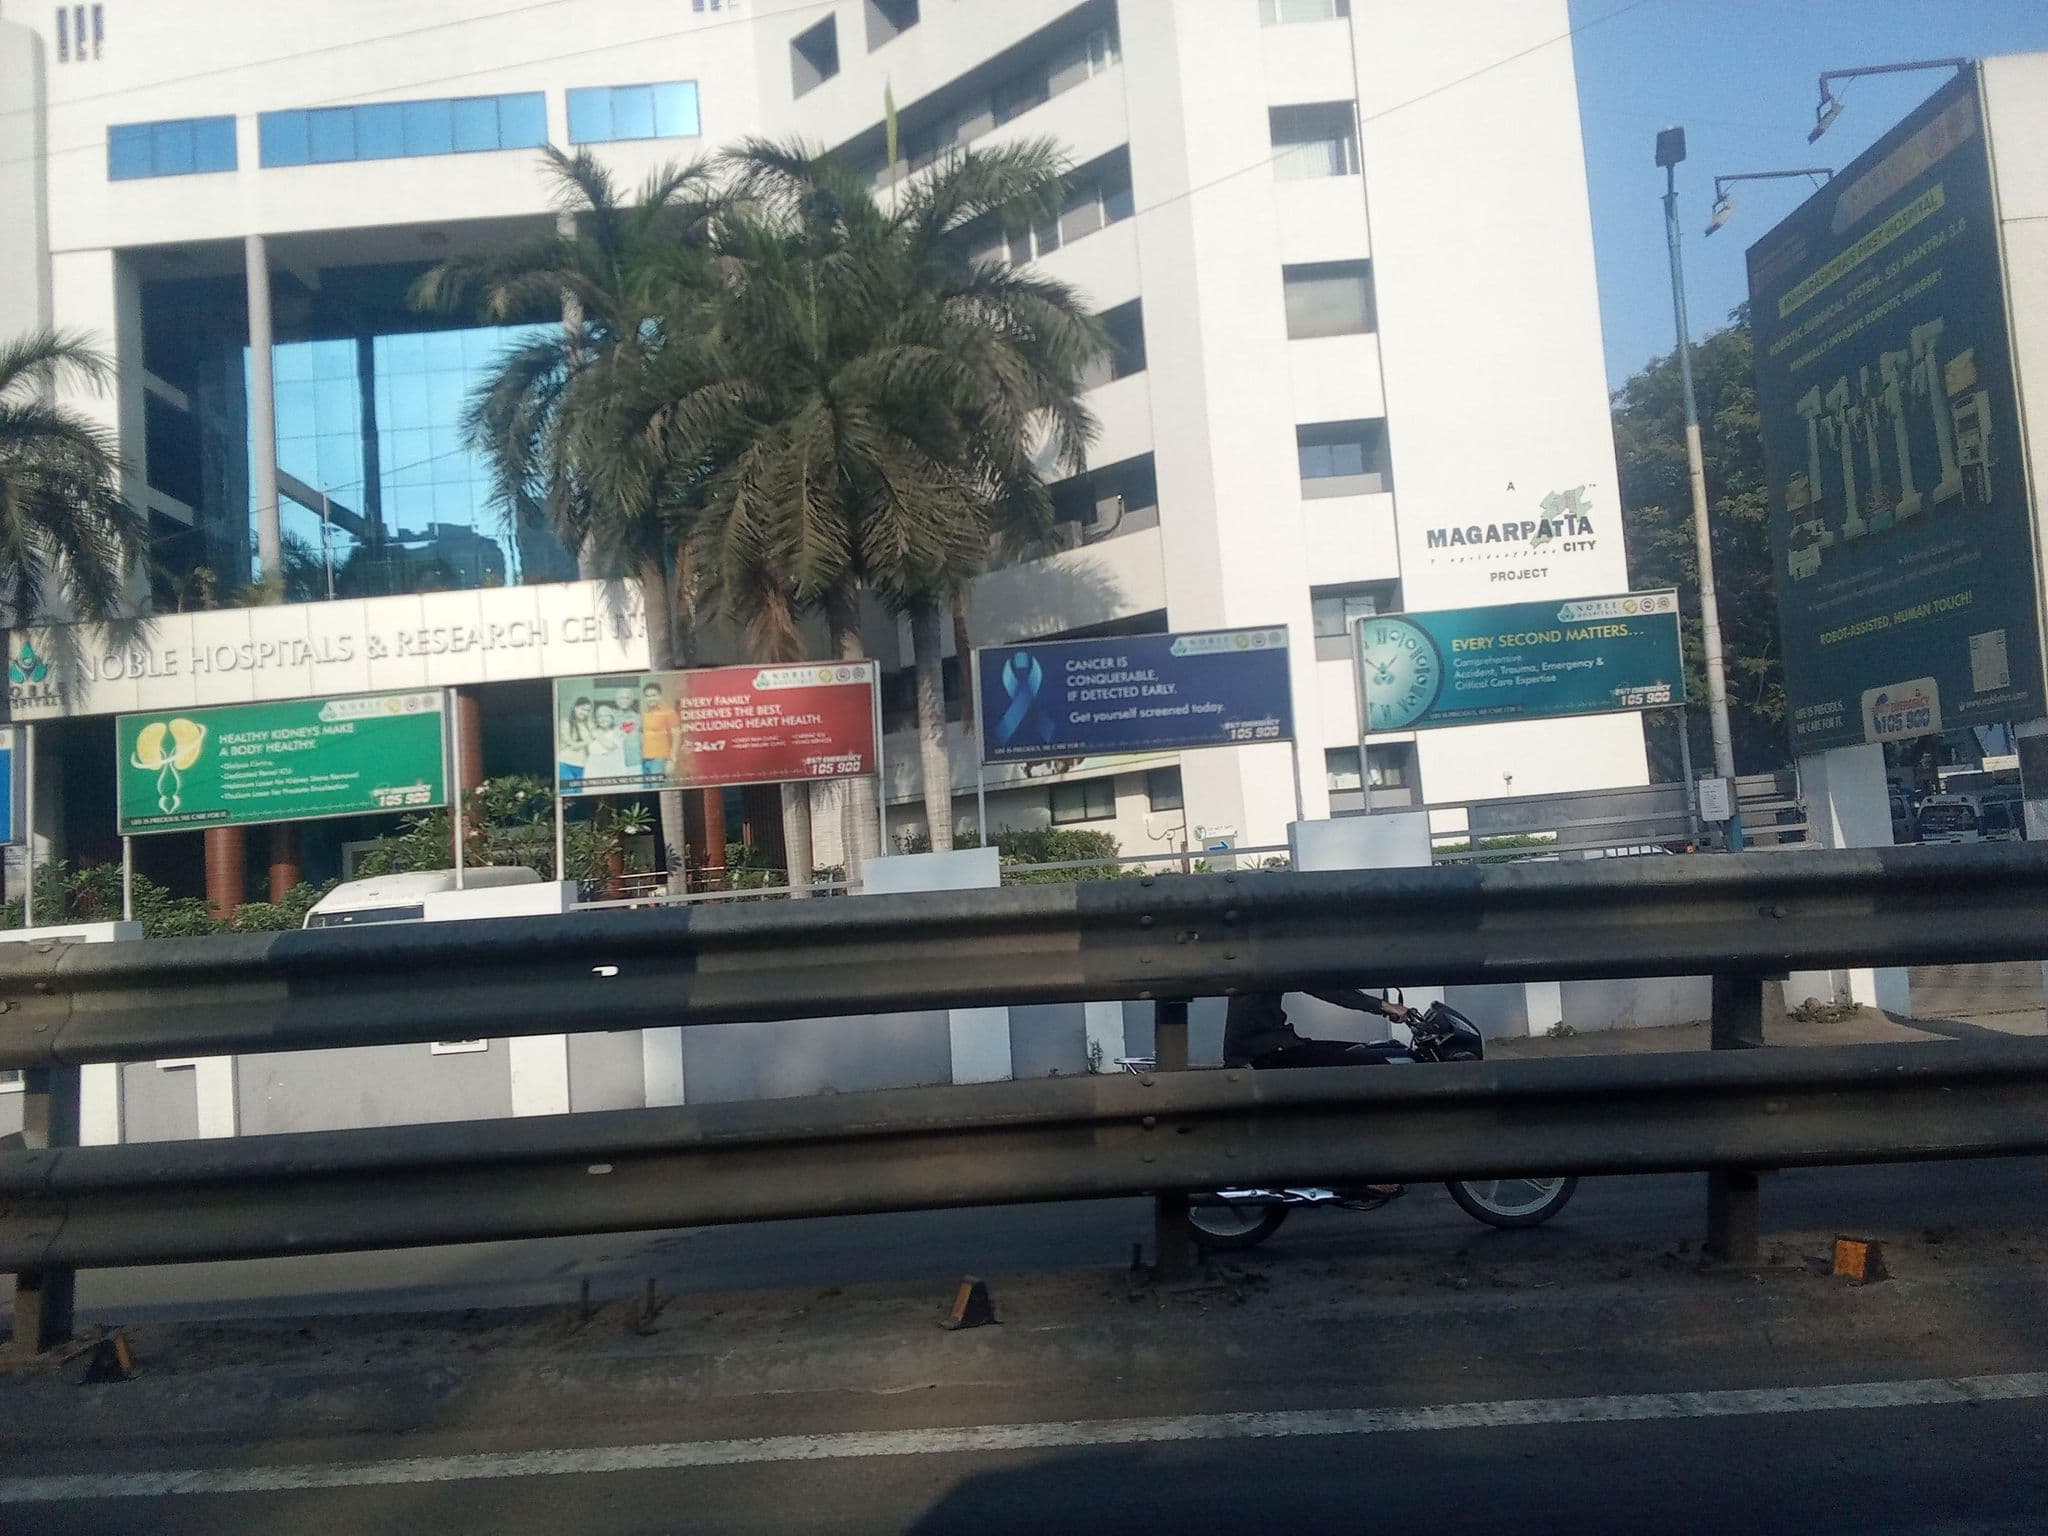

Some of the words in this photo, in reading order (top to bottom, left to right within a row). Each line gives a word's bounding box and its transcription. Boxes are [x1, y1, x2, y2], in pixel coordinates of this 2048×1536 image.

[1885, 191, 1937, 237] HOSPITAL
[1506, 481, 1515, 491] A
[1426, 513, 1594, 549] MAGARPATTA
[1563, 540, 1597, 552] CITY
[1490, 568, 1548, 582] PROJECT
[1820, 615, 1892, 645] ROBOT-ASSISTED,
[1894, 604, 1931, 625] HUMAN
[1934, 590, 1974, 613] TOUCH!
[1452, 636, 1494, 652] EVERY
[1499, 631, 1562, 648] SECOND
[1566, 624, 1645, 641] MATTERS...
[76, 648, 178, 682] NOBLE
[190, 635, 354, 674] HOSPITALS
[368, 635, 388, 659] &
[397, 620, 549, 657] RESEARCH
[1065, 658, 1115, 672] CANCER
[1117, 656, 1128, 668] IS
[1542, 658, 1594, 672] Emergency
[1596, 657, 1605, 666] &
[1066, 669, 1159, 687] CONQUERABLE,
[1490, 676, 1514, 688] Care
[1516, 674, 1558, 687] Expertise
[1067, 690, 1079, 702] IF
[1081, 685, 1139, 701] DETECTED
[680, 696, 713, 709] EVERY
[714, 695, 751, 706] FAMILY
[680, 706, 732, 720] DESERVES
[735, 706, 755, 717] THE
[1069, 711, 1091, 724] Get
[1093, 707, 1137, 724] yourself
[1140, 703, 1190, 719] screened
[681, 719, 744, 733] INCLUDING
[745, 717, 780, 729] HEART
[219, 731, 268, 744] HEALTHY
[271, 726, 320, 740] KIDNEYS
[321, 723, 354, 735] MAKE
[219, 747, 228, 756] A
[230, 744, 264, 756] BODY
[694, 740, 726, 752] 24x7
[812, 763, 834, 775] 105
[837, 761, 861, 773] 900
